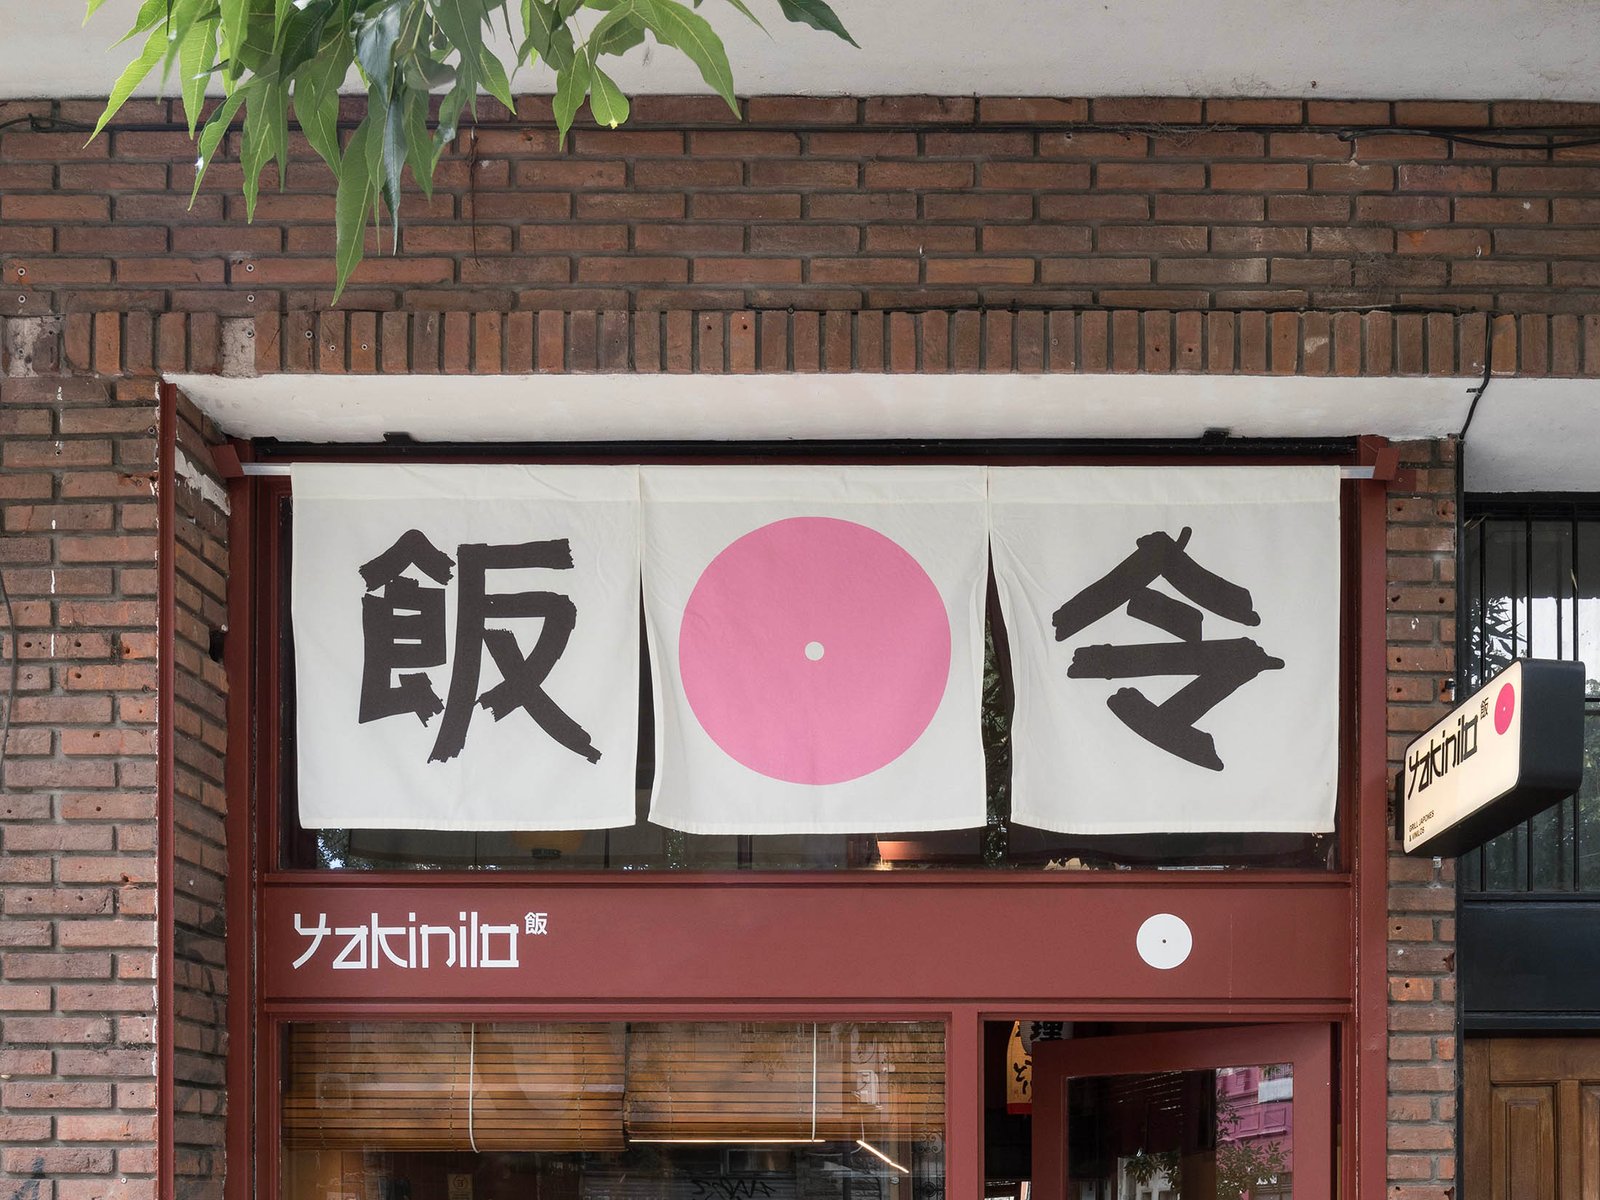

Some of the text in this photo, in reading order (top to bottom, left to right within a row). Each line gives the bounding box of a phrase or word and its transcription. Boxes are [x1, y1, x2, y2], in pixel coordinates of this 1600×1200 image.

[358, 528, 602, 765] 飯
[292, 911, 519, 970] Yakinilo
[524, 912, 548, 936] 飯
